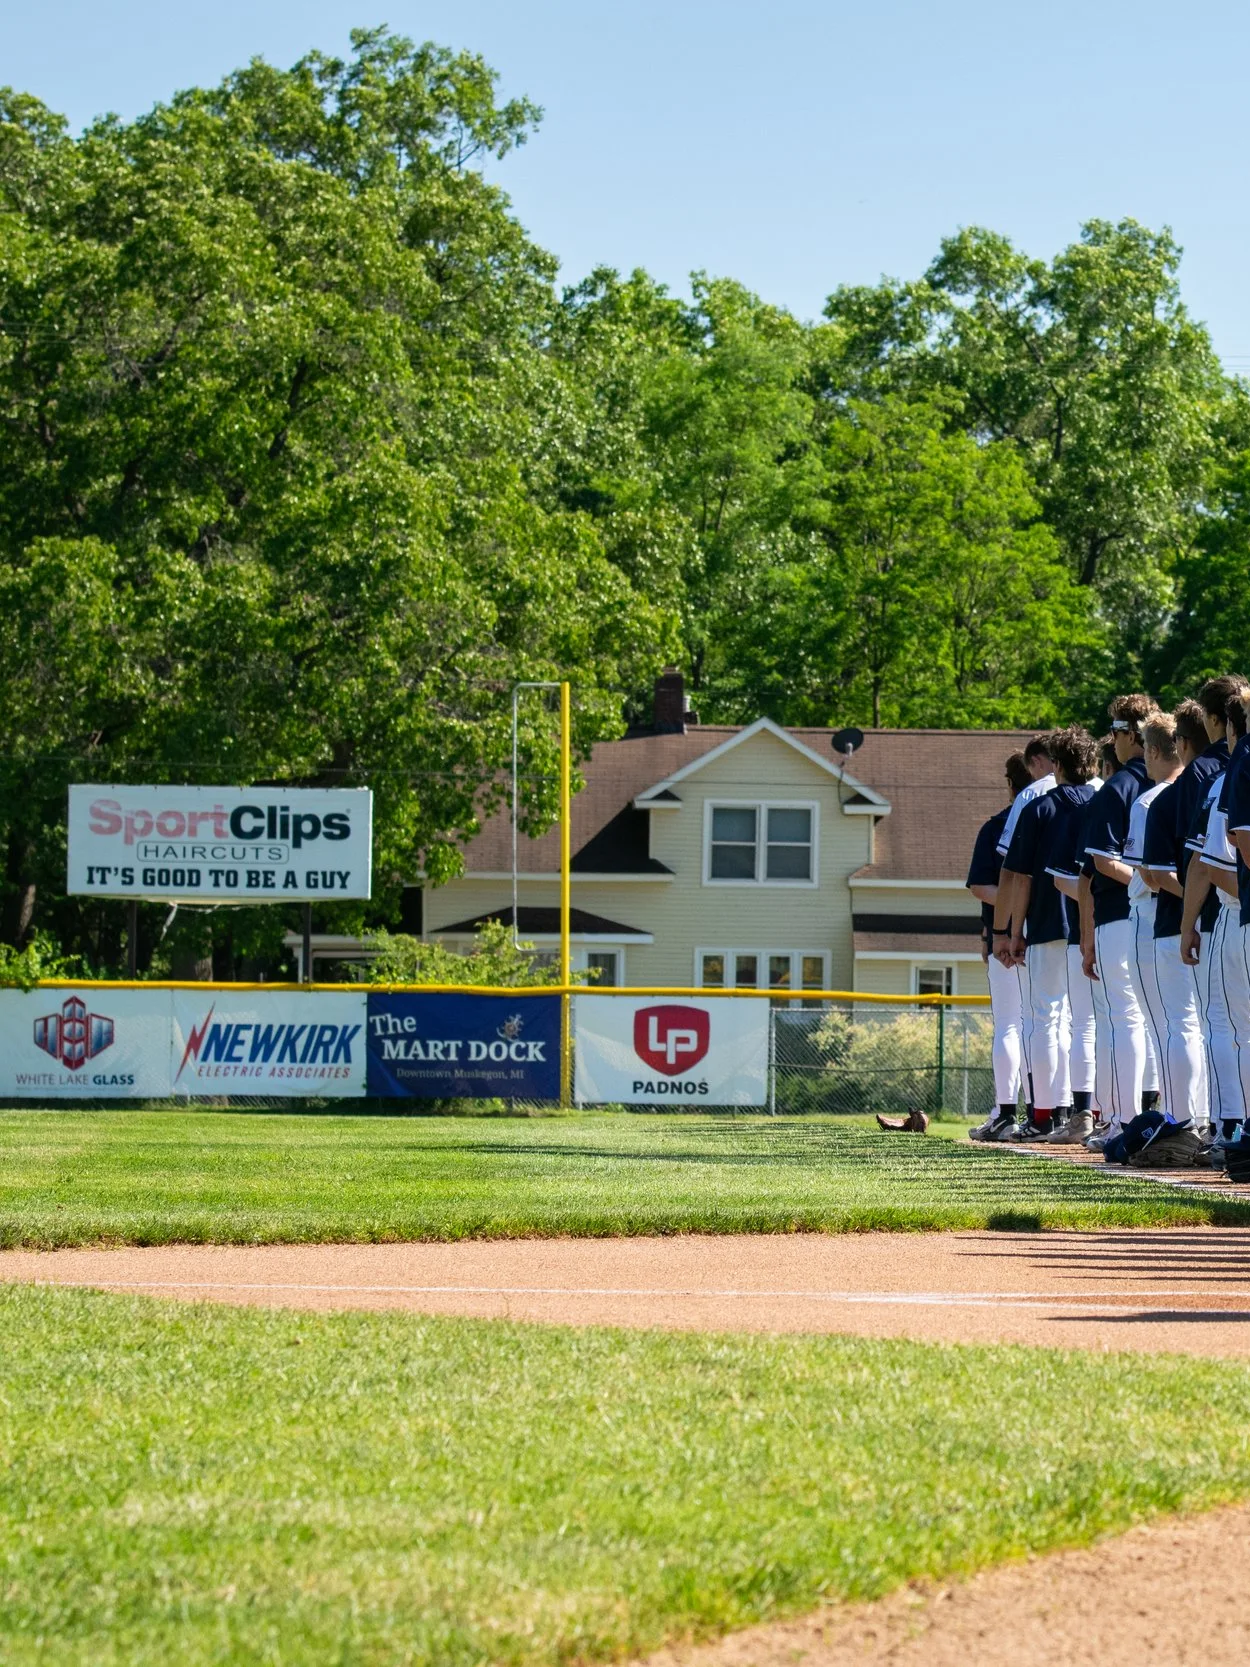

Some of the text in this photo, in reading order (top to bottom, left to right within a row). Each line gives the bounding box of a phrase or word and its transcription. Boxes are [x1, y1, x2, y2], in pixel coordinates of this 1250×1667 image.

[143, 845, 282, 861] HAIRCUTS
[86, 866, 351, 889] IT'S GOOD TO BE A GUY
[369, 1012, 417, 1037] The
[201, 1023, 362, 1064] NEWKIRK
[381, 1039, 547, 1063] MART DOCK
[15, 1073, 135, 1087] WHITE LAKE GLASS
[198, 1065, 351, 1079] ELECTRIC ASSOCIATES
[396, 1068, 452, 1079] Downtown
[510, 1070, 525, 1080] MI
[632, 1080, 710, 1096] PADNOS
